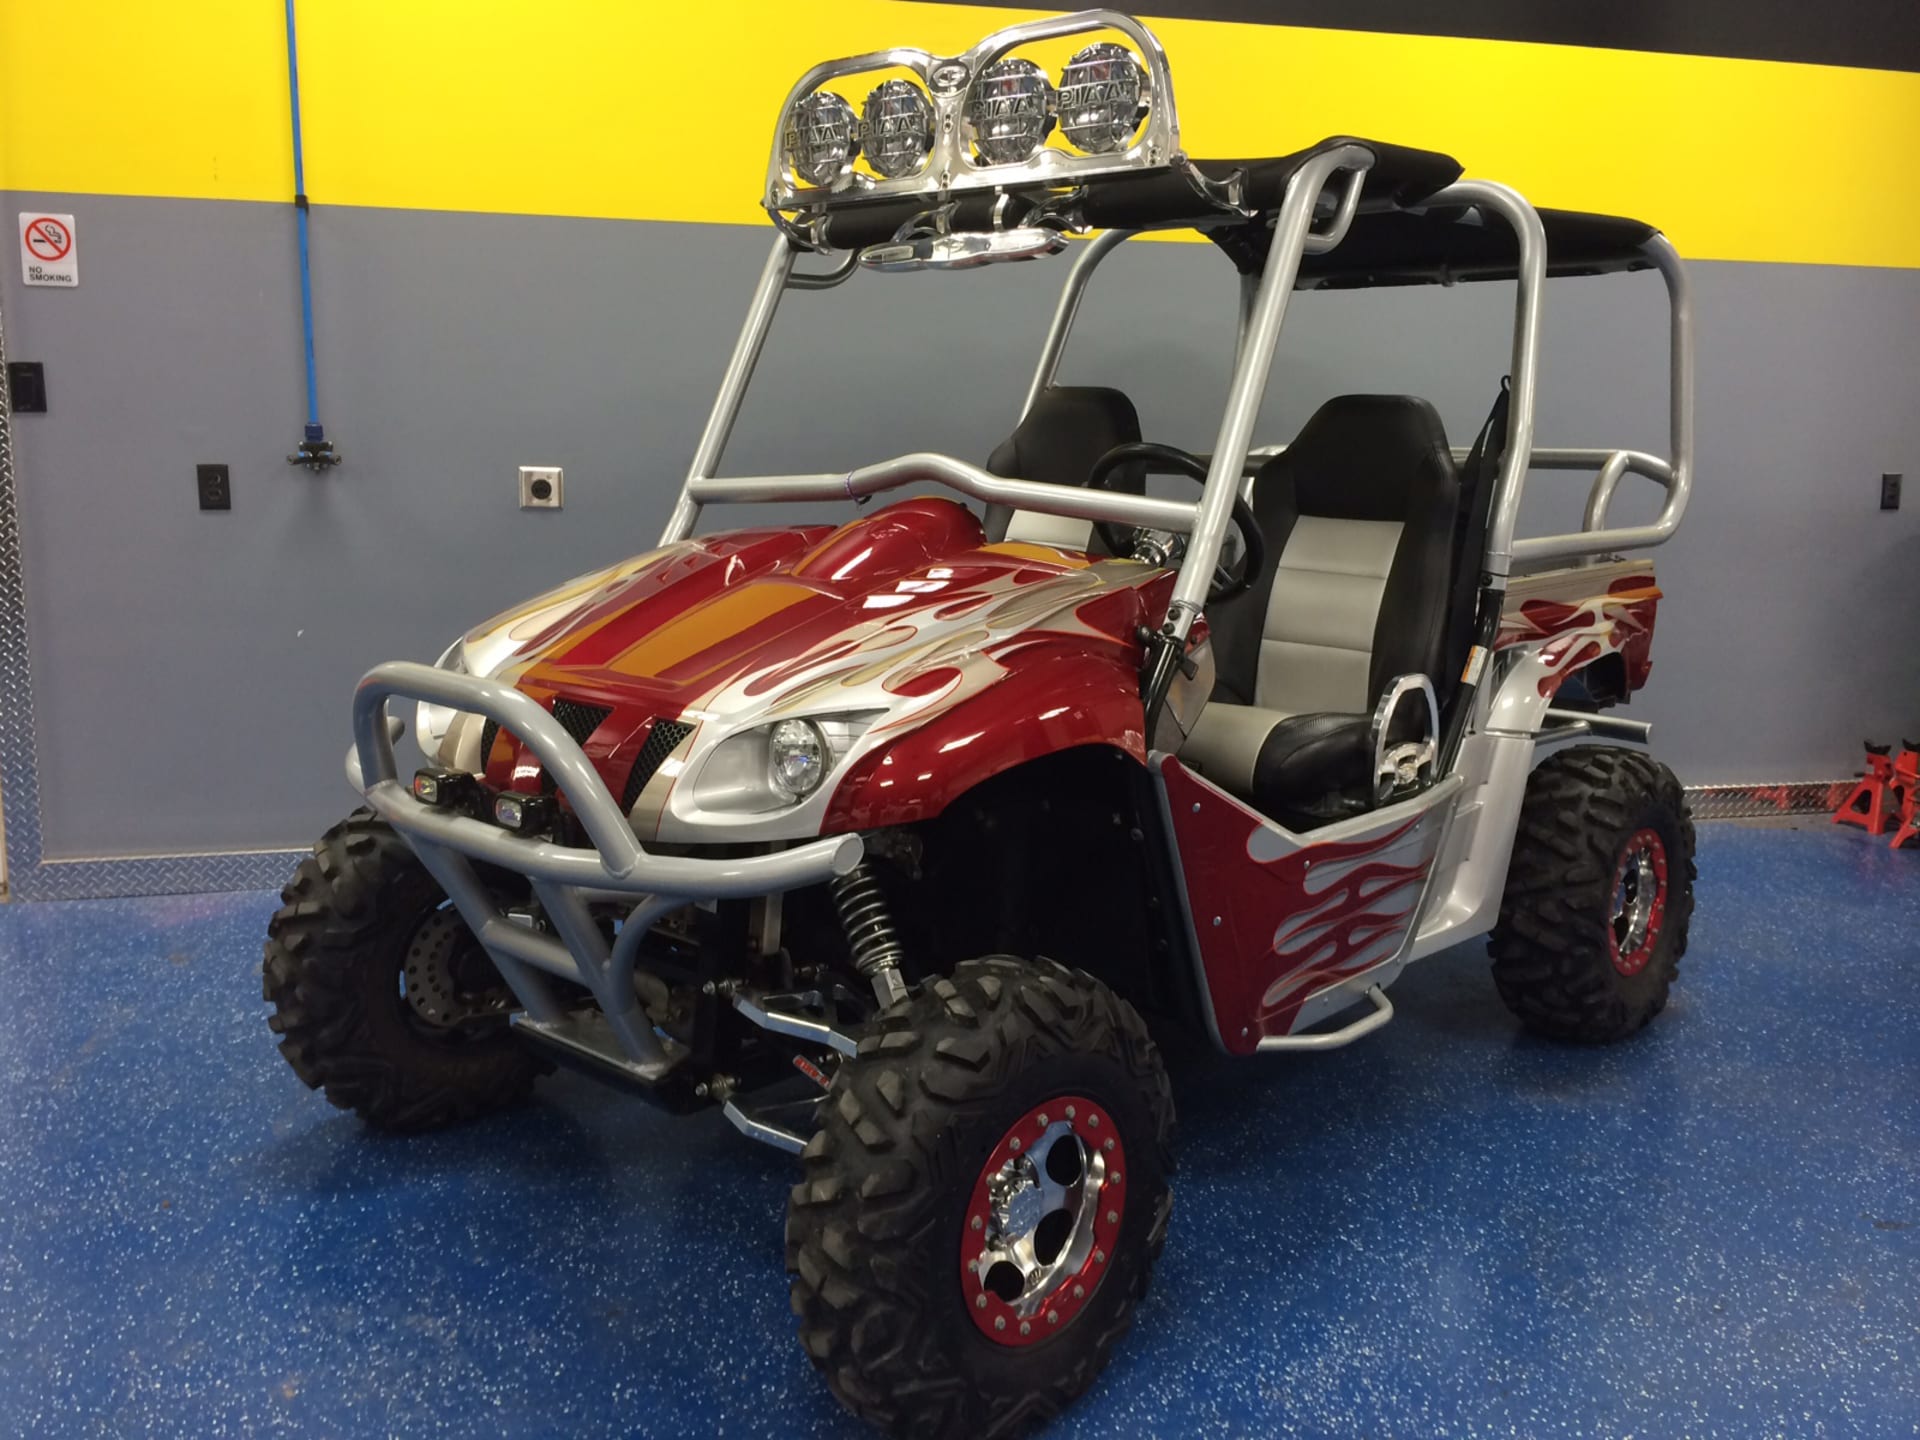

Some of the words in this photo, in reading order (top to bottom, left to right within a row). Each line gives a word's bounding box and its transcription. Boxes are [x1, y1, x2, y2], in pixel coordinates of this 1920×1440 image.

[1057, 81, 1123, 109] PIAA
[972, 96, 1030, 119] PIAA
[786, 125, 838, 149] PIAA
[858, 119, 917, 138] PIAA
[29, 273, 72, 282] SMOKING
